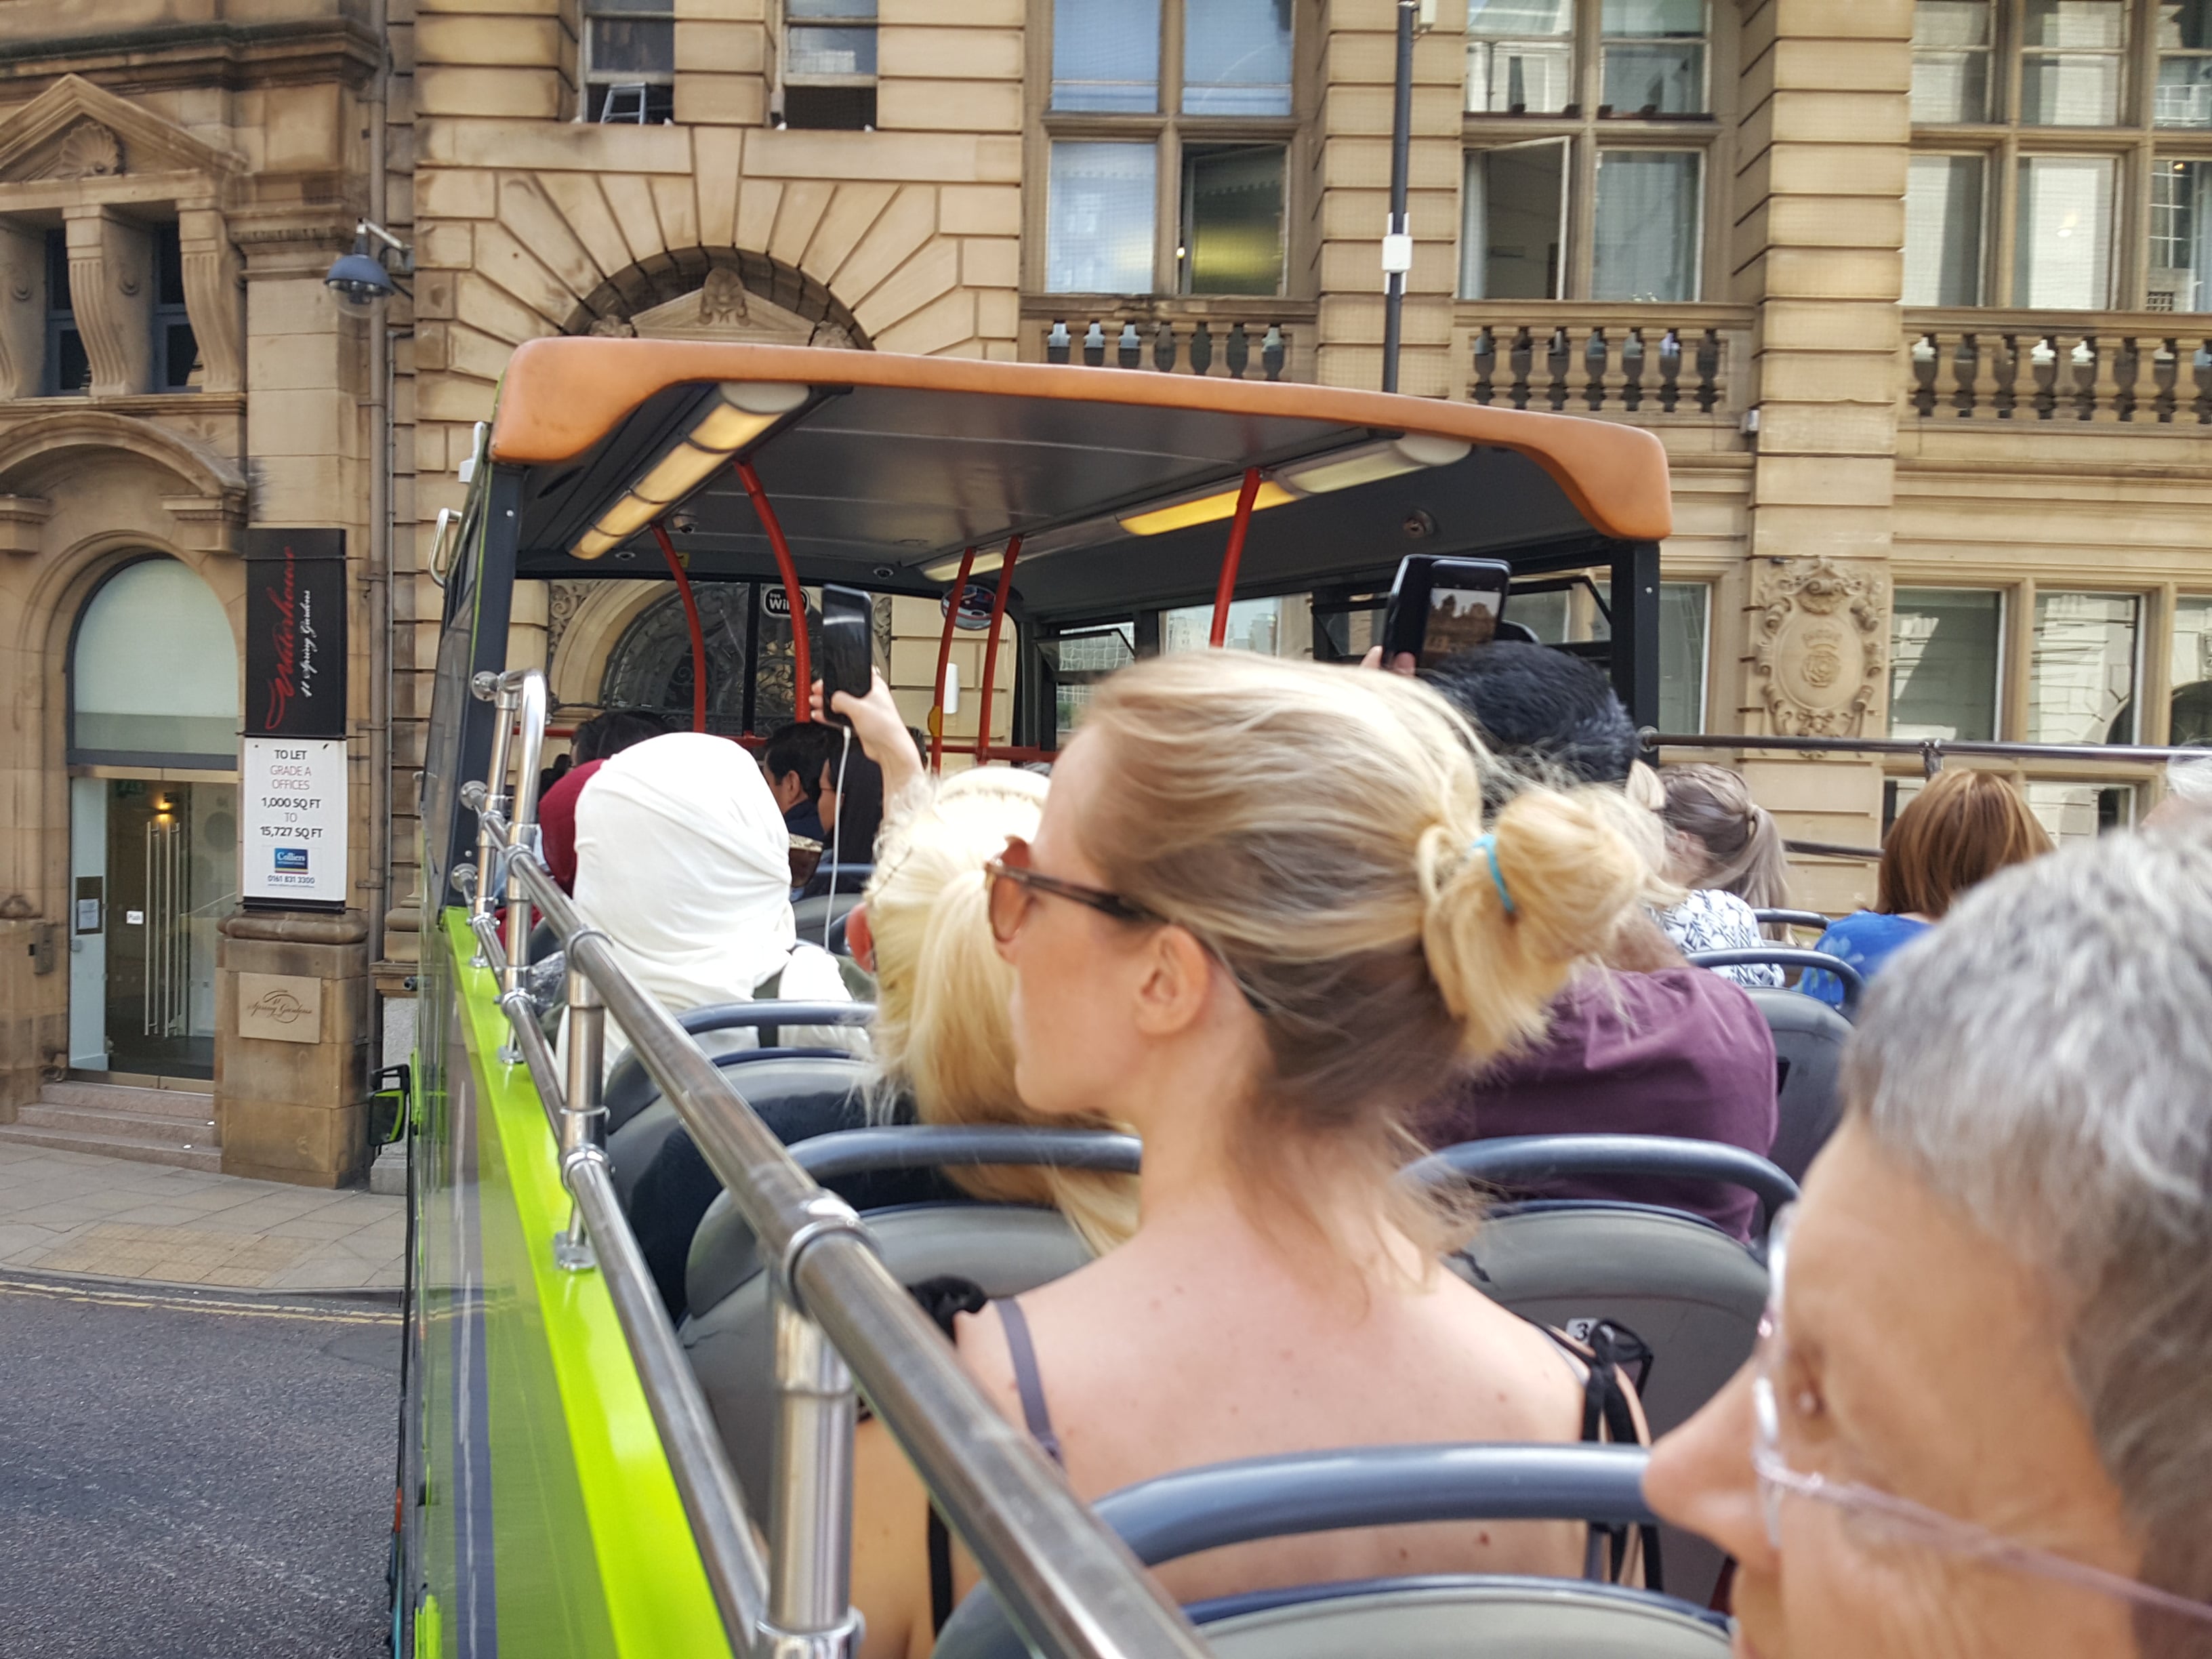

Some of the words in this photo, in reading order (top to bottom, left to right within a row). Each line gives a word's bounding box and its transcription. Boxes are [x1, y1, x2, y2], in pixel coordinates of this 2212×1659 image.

[274, 750, 288, 759] TO
[290, 750, 308, 760] LET
[270, 765, 303, 775] GRADE
[305, 766, 312, 776] A
[272, 779, 310, 790] OFFICES
[262, 797, 291, 808] 1,000
[293, 798, 308, 810] SQ
[309, 799, 321, 808] FT
[284, 813, 298, 822] TO
[260, 826, 293, 837] 15,727
[295, 827, 309, 840] SQ
[311, 828, 323, 838] FT
[1574, 1322, 1589, 1341] 3
